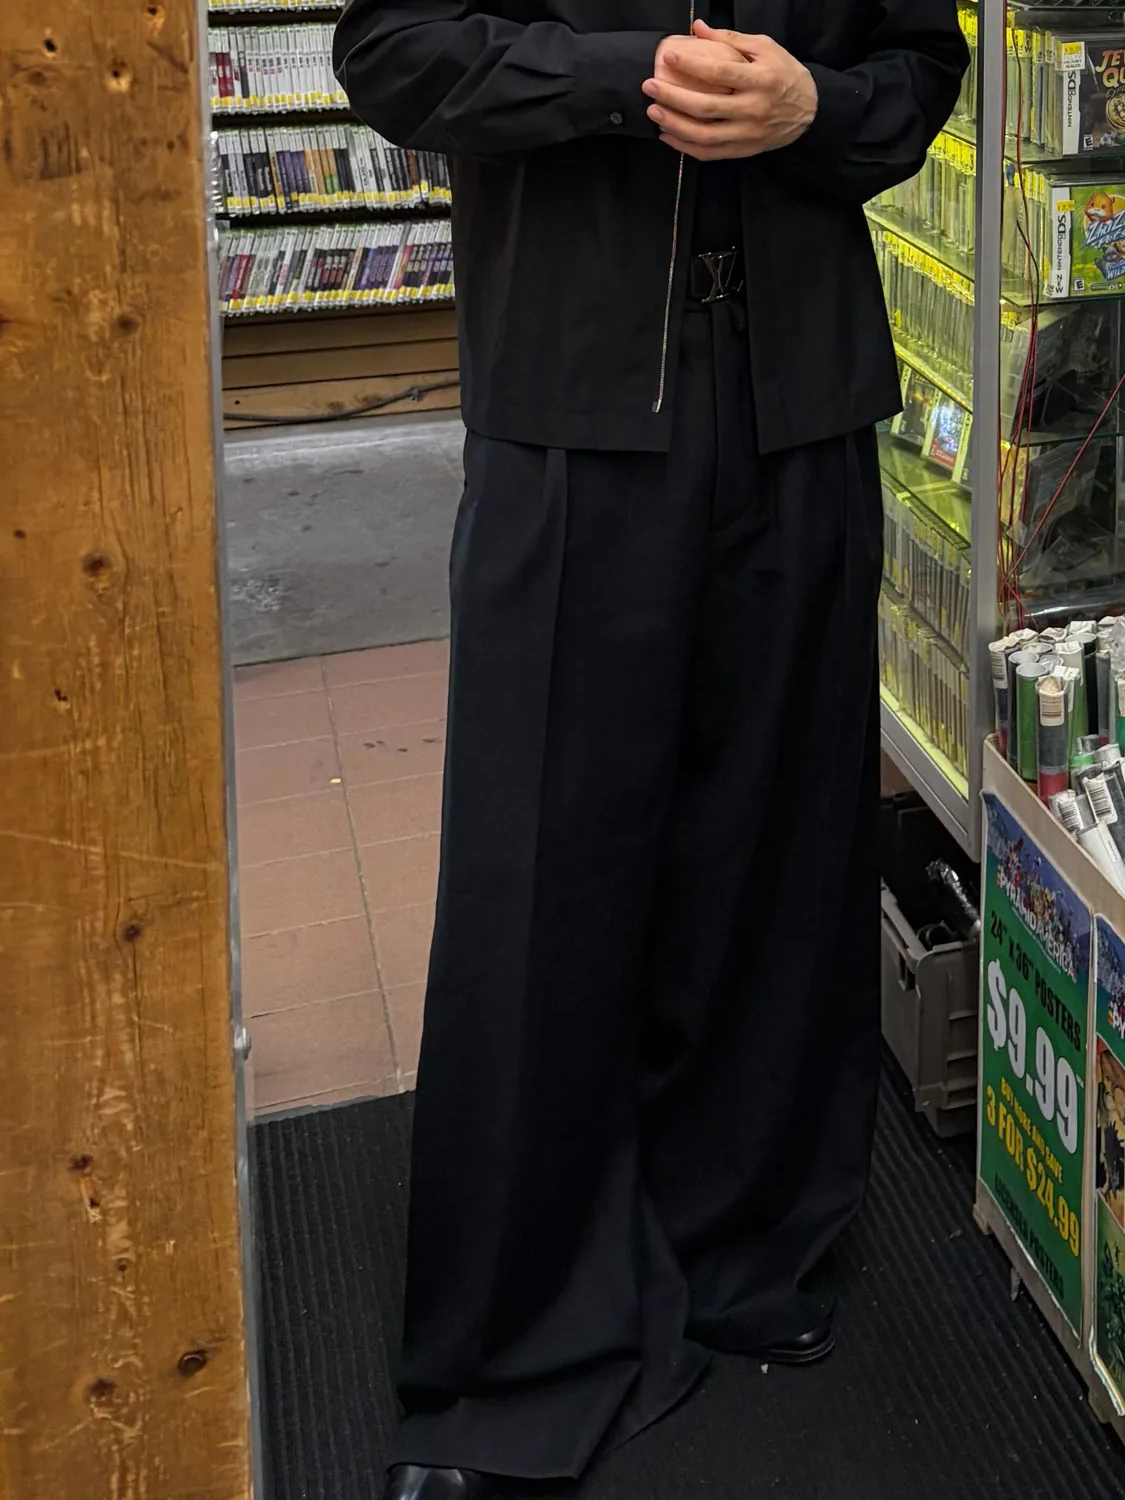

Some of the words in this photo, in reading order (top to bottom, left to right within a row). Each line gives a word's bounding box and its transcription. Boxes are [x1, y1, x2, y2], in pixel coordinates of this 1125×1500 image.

[1067, 71, 1076, 90] DS
[1057, 214, 1066, 233] DS
[986, 958, 1078, 1155] $9.99
[1034, 969, 1082, 1053] POSTERS
[986, 1084, 996, 1128] 3
[997, 1101, 1024, 1173] FOR
[1026, 1147, 1080, 1258] $24.99
[1001, 1077, 1013, 1106] BUY
[1013, 1096, 1031, 1137] MORE
[1031, 1125, 1046, 1156] AND
[1045, 1147, 1063, 1185] SAVE
[995, 1171, 1025, 1240] LICENSED
[1026, 1231, 1064, 1301] POSTERS
